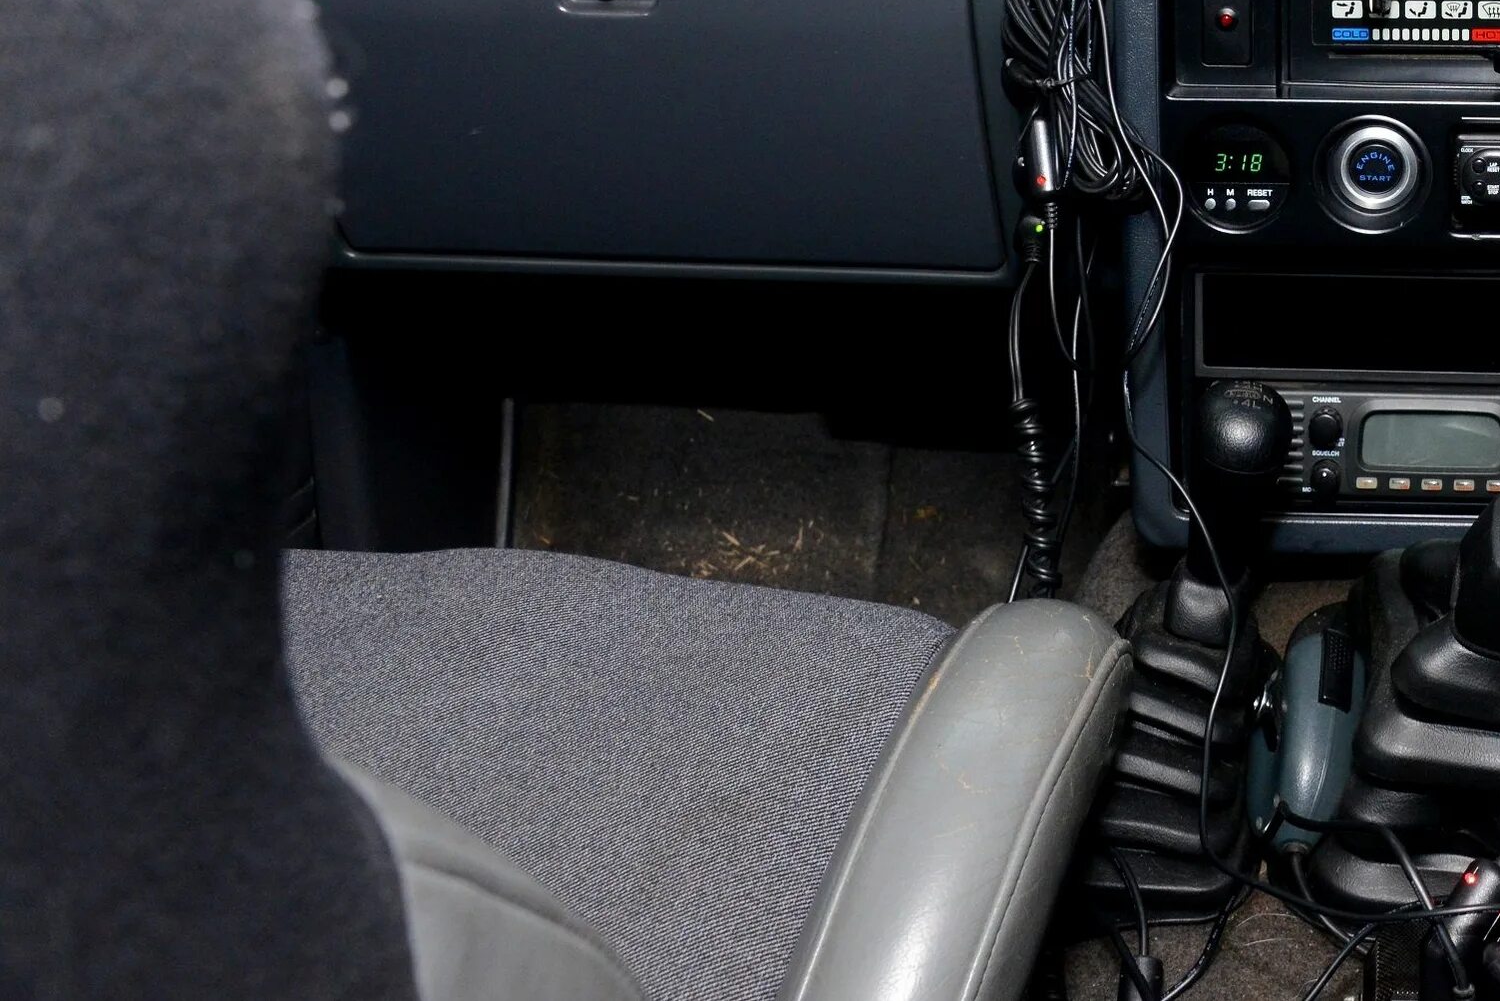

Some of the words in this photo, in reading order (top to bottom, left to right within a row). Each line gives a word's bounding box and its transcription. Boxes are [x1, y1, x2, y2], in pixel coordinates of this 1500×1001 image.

[1333, 30, 1369, 38] COLD
[1215, 153, 1262, 172] 3:18
[1356, 151, 1395, 172] ENGINE
[1207, 188, 1214, 196] H
[1226, 188, 1235, 196] M
